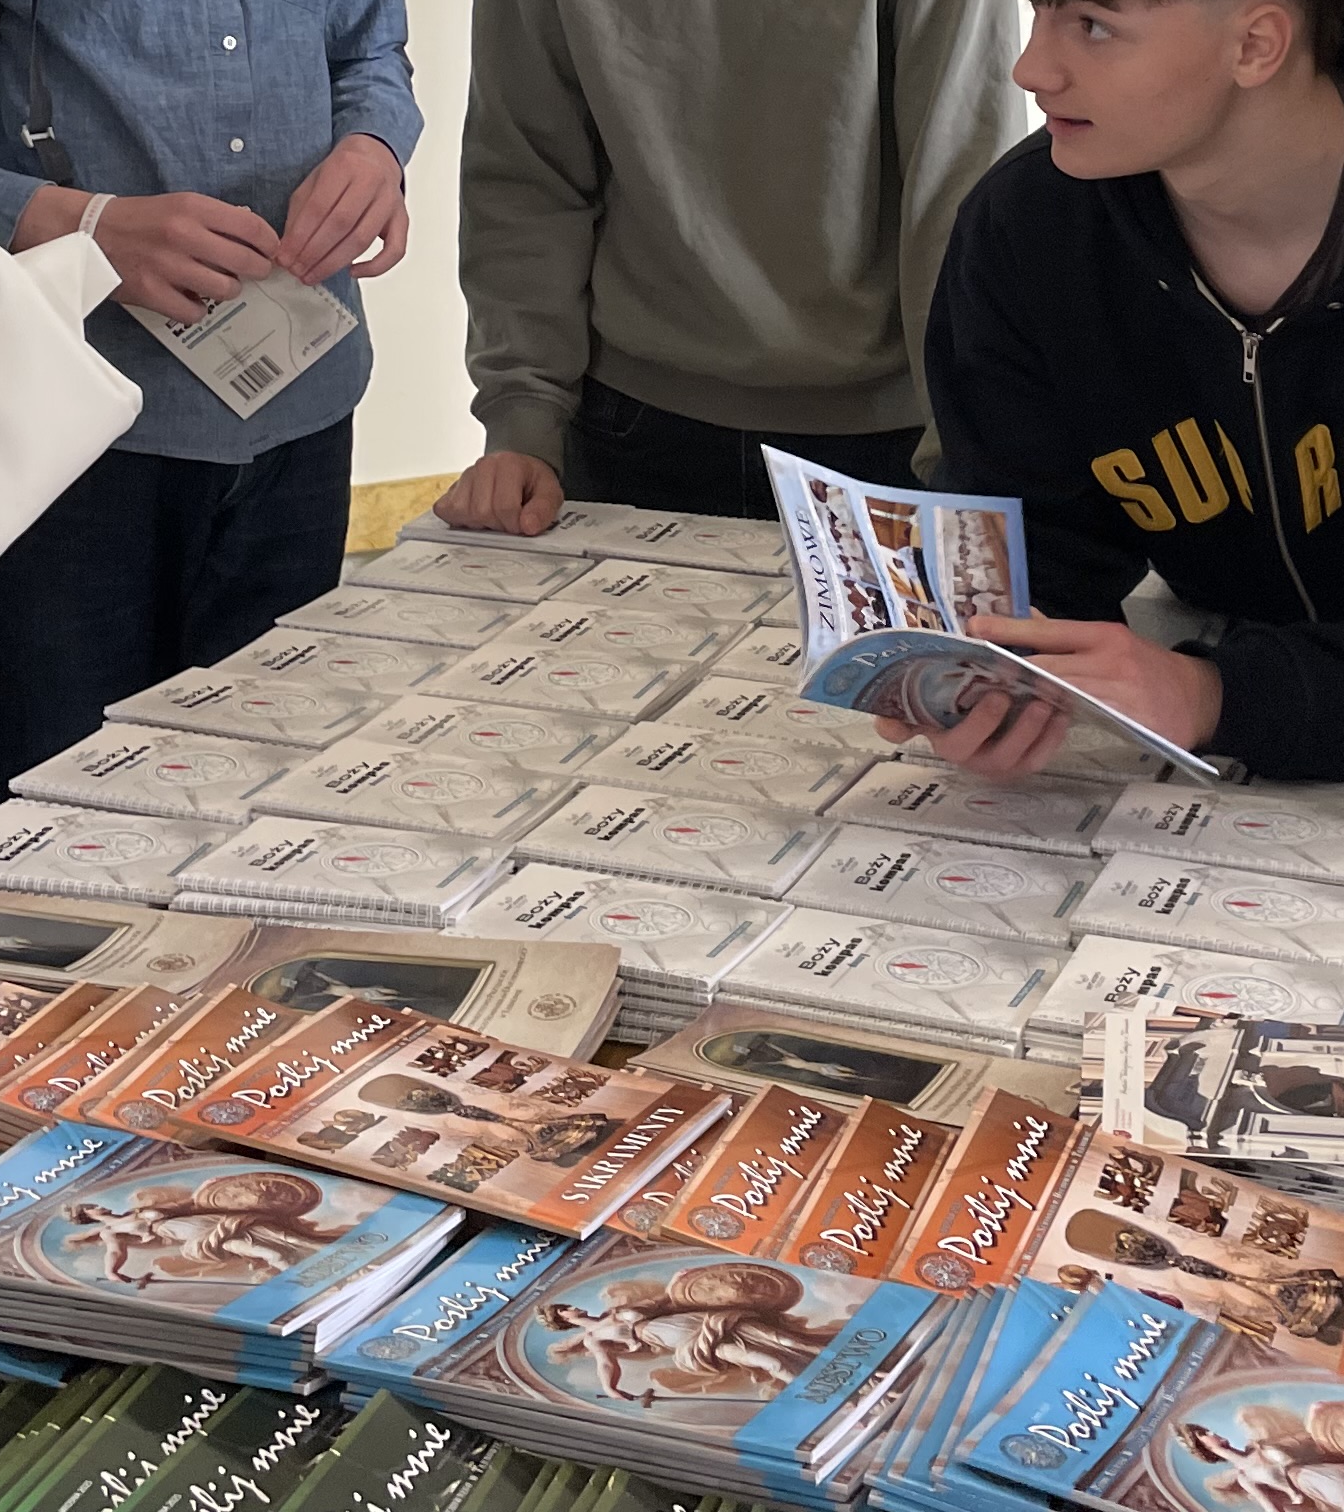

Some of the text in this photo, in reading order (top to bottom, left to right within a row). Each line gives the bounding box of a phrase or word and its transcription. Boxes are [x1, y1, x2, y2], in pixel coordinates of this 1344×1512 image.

[796, 509, 837, 633] ZIMOWE
[325, 761, 369, 789] Boży
[637, 742, 675, 768] Boży
[584, 807, 626, 837] Boży
[887, 782, 922, 808] Boży
[1155, 803, 1185, 830] Boży
[248, 839, 294, 869] Boży
[853, 852, 891, 885] Boży
[515, 891, 562, 923] Boży
[1137, 877, 1171, 908] Boży
[798, 937, 841, 970] Boży
[140, 1046, 224, 1112] Poślij
[224, 1006, 280, 1063] mnie
[232, 1045, 332, 1110] Poślij
[331, 1012, 391, 1058] mnie
[33, 1136, 105, 1189] mnie
[561, 1103, 685, 1205] SAKRAMENTY
[711, 1104, 824, 1220] Poślij mnie
[820, 1123, 923, 1256] Poślij mnie
[938, 1180, 1034, 1266] Poślij
[1006, 1115, 1051, 1181] mnie
[392, 1283, 511, 1345] Poślij
[1027, 1376, 1137, 1453] Poślij
[1112, 1312, 1169, 1388] mnie
[160, 1387, 226, 1456] mnie
[252, 1402, 321, 1472] mnie
[387, 1422, 452, 1495] mnie
